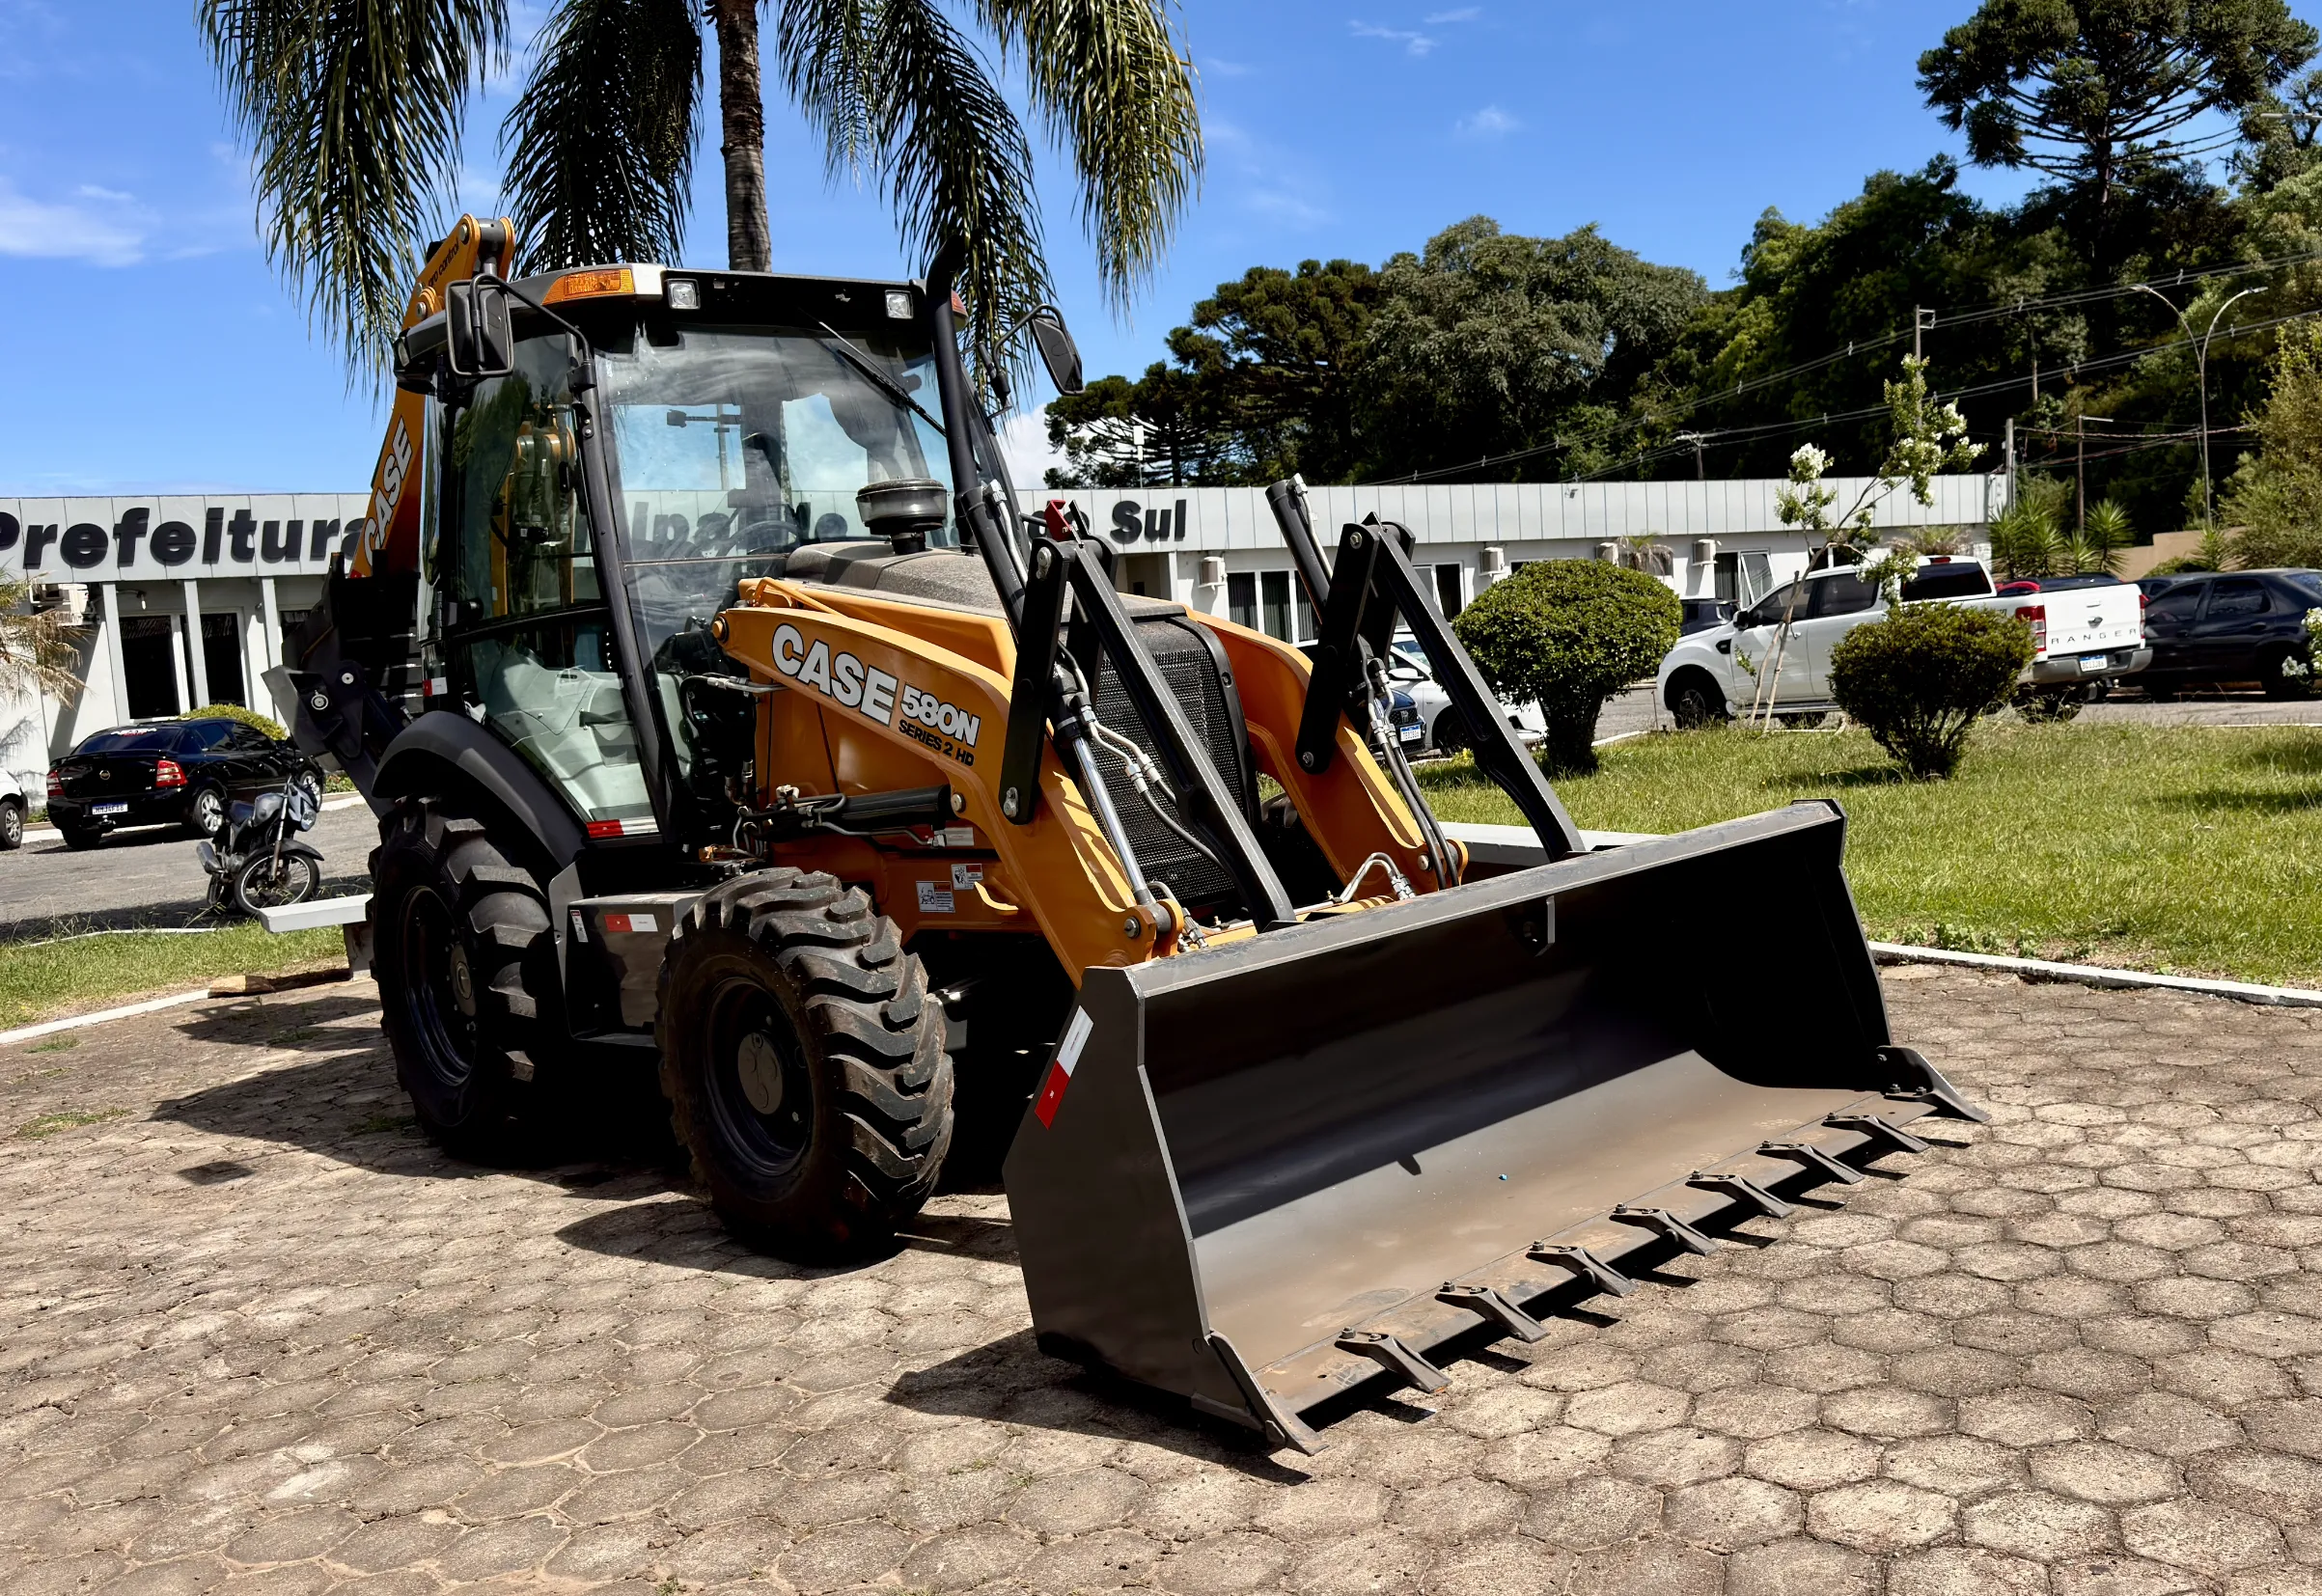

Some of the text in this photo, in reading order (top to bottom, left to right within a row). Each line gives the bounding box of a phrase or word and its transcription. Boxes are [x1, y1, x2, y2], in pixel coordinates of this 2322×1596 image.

[363, 414, 413, 567] CASE
[1110, 499, 1187, 544] Sul
[2051, 628, 2137, 646] RANGER
[772, 622, 899, 729] CASE
[898, 719, 976, 767] SERIES 2 HD
[900, 681, 981, 749] 580N
